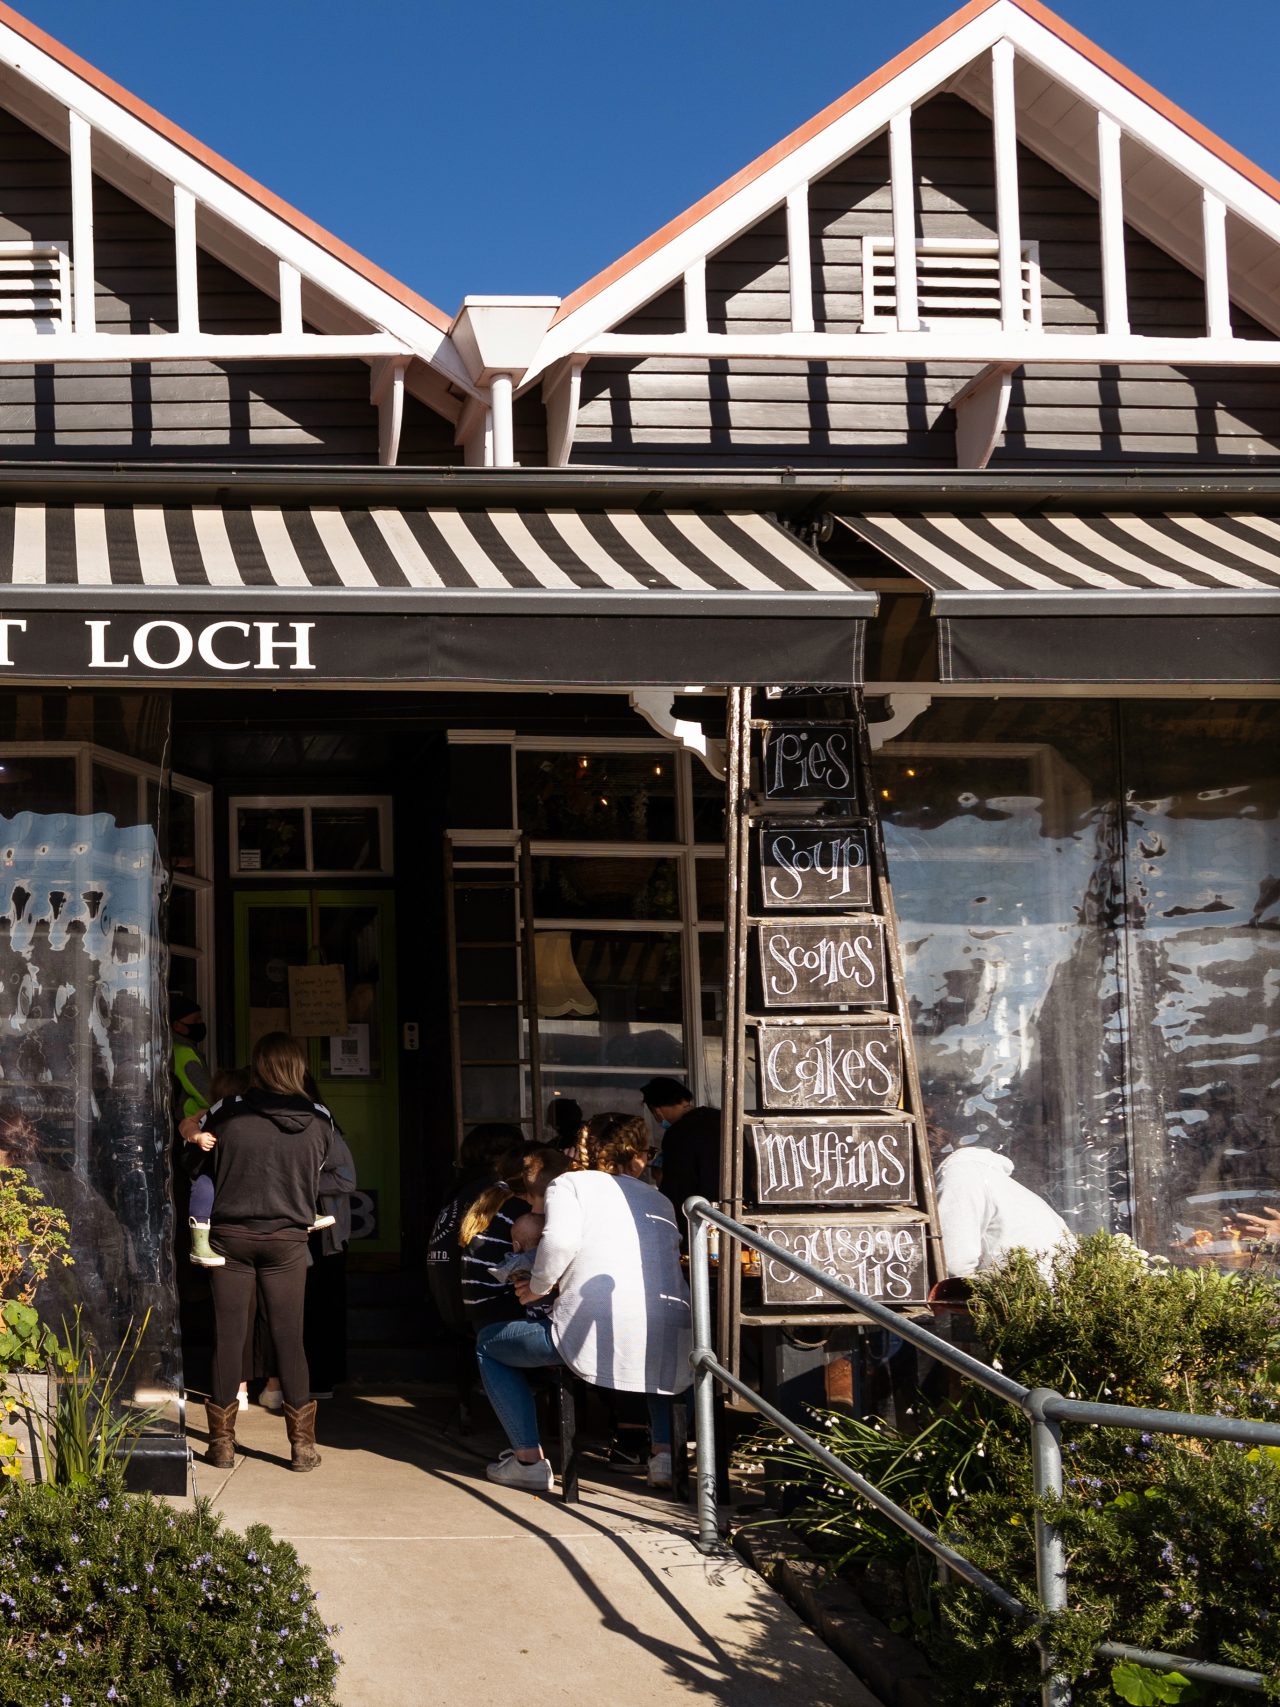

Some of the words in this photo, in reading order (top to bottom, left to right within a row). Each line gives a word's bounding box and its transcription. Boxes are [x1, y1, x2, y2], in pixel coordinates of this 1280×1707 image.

[86, 620, 317, 670] LOCH
[767, 732, 850, 795] Pies
[770, 835, 864, 900] Soup
[769, 934, 876, 995] Scones
[767, 1033, 893, 1104] Cakes
